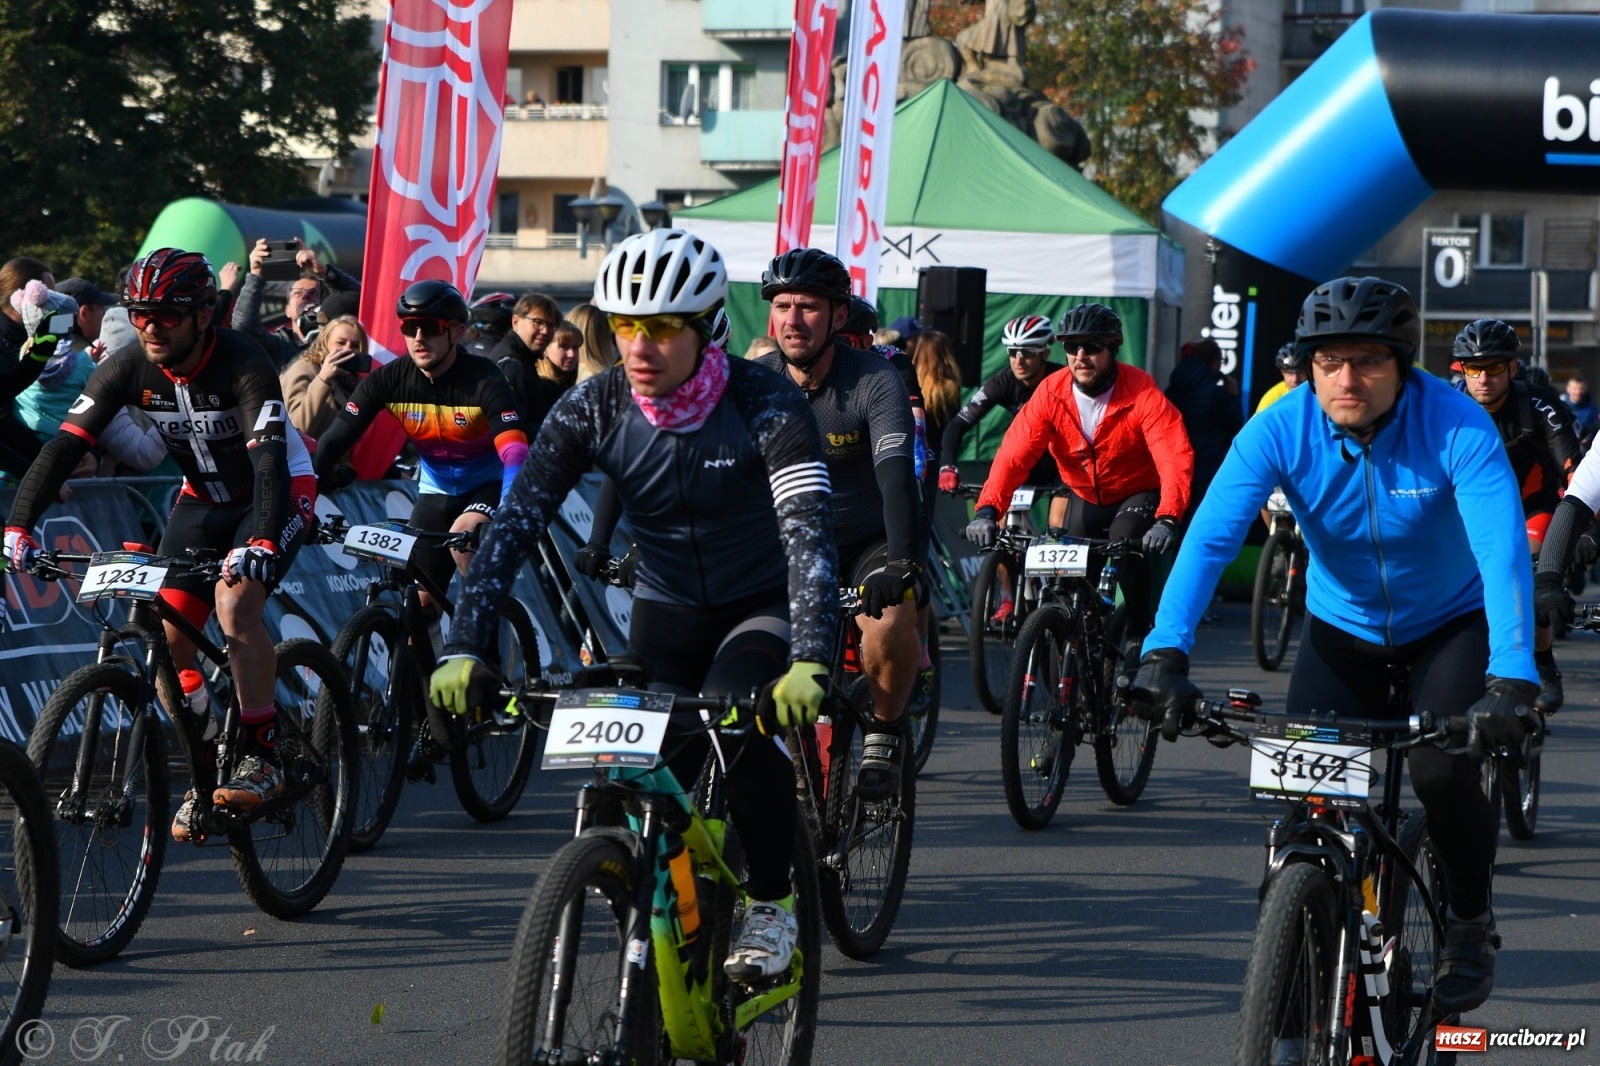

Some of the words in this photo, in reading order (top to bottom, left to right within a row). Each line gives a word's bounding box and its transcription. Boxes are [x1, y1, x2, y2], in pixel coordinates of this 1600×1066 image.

[1431, 235, 1471, 247] SEKTOR
[1434, 247, 1465, 288] 0
[357, 530, 402, 552] 1382
[1038, 549, 1078, 563] 1372
[96, 569, 148, 585] 1231
[566, 721, 644, 744] 2400
[1270, 751, 1347, 783] 3162
